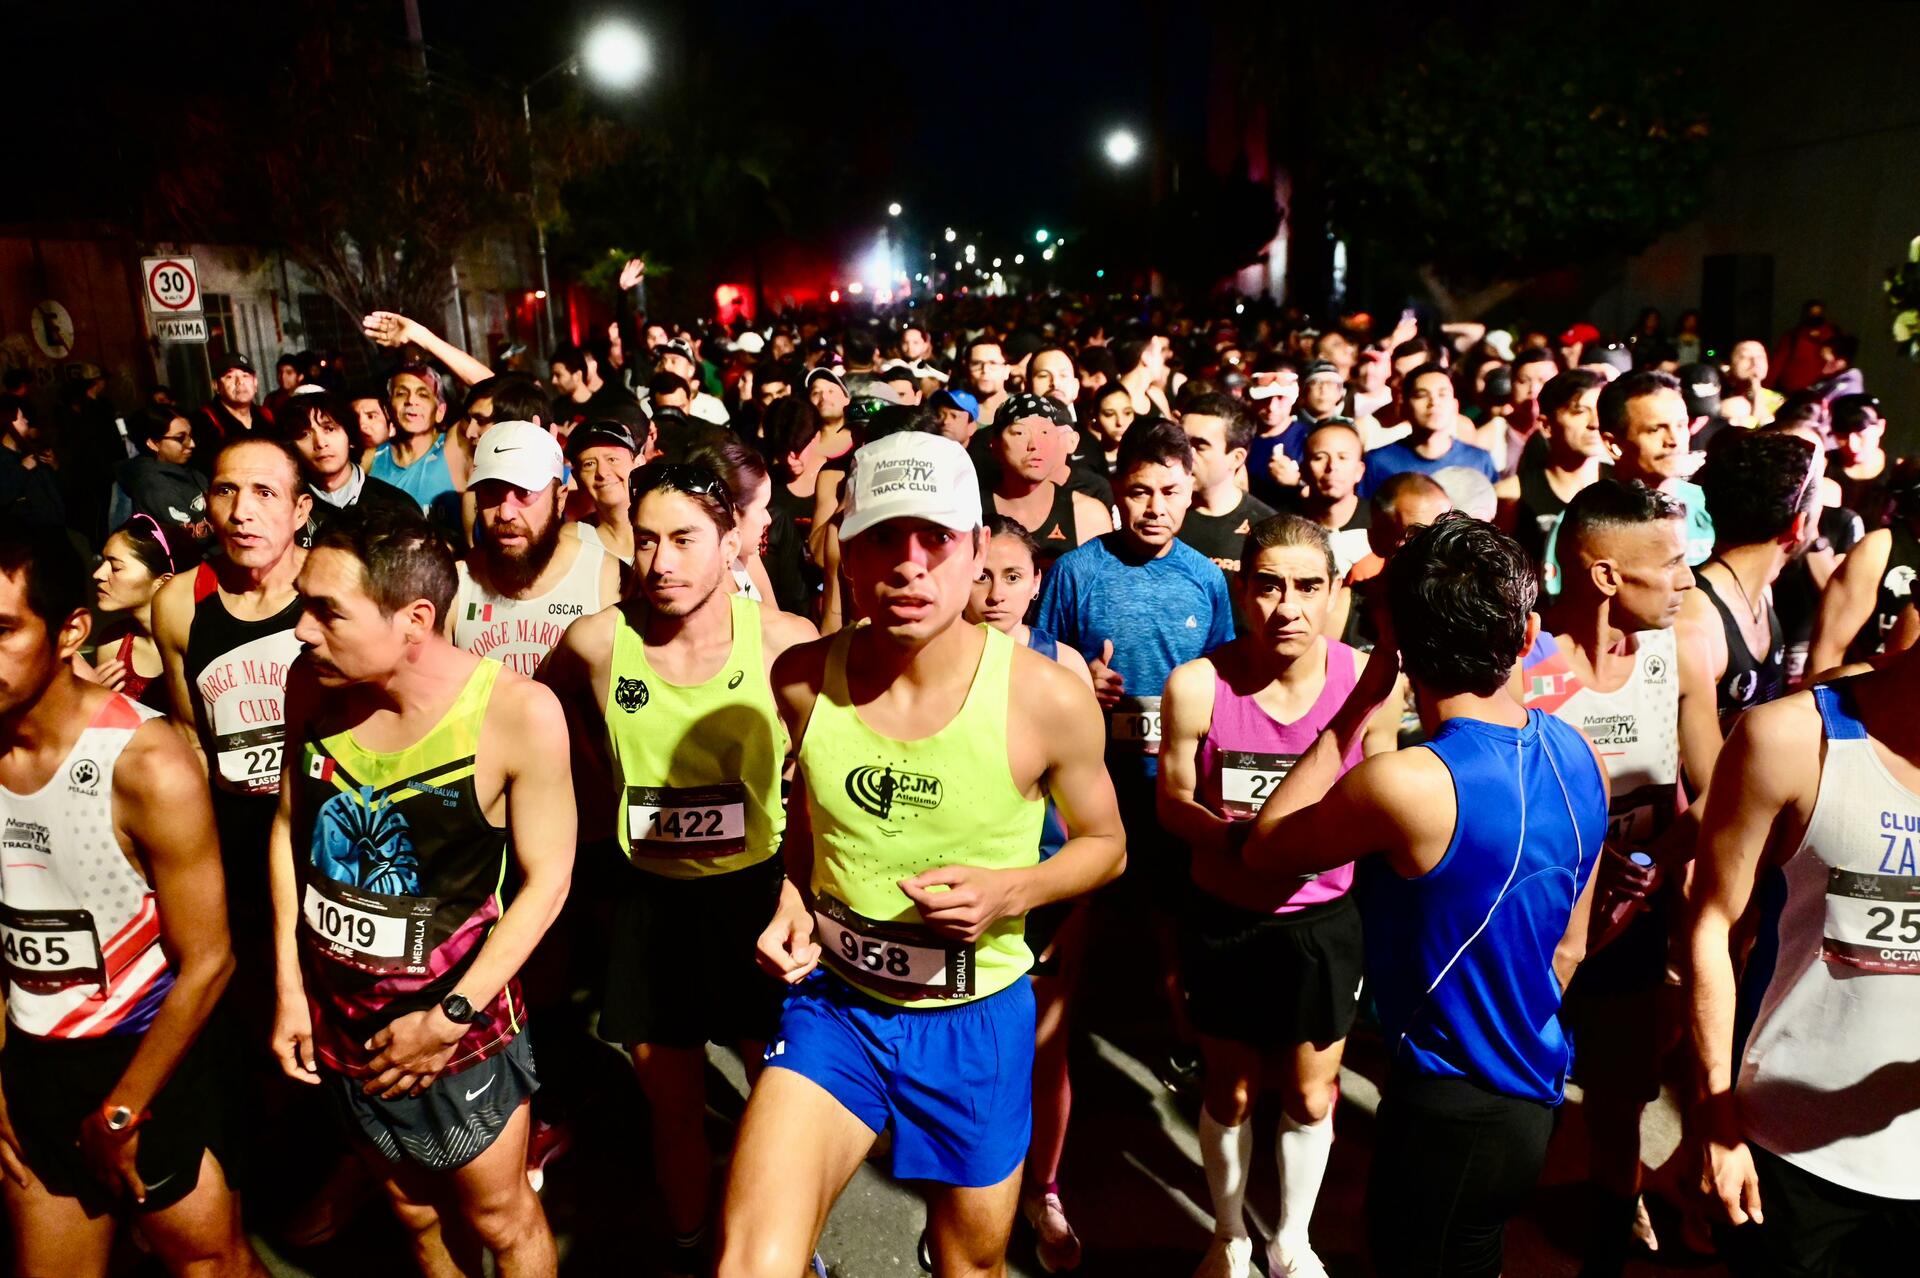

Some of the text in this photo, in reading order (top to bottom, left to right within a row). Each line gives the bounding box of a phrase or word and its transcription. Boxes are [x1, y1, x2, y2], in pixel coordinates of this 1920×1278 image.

[158, 271, 184, 292] 30
[158, 323, 203, 336] MAXIMA
[873, 458, 933, 472] Marathon
[912, 468, 934, 481] TV
[871, 482, 938, 497] TRACK CLUB
[548, 603, 584, 615] OSCAR
[202, 663, 238, 705] ORGE
[239, 698, 281, 724] CLUB
[1583, 714, 1635, 725] Marathon
[1617, 722, 1635, 736] TV
[1613, 736, 1639, 745] CLUB
[244, 745, 284, 775] 22
[248, 777, 270, 787] BLAS
[900, 774, 940, 796] CJM
[895, 792, 937, 806] Atletismo
[6, 817, 49, 832] Marathon
[649, 809, 724, 839] 1422
[2, 841, 32, 849] TRACK
[36, 831, 50, 844] TV
[1878, 833, 1920, 878] ZA
[317, 901, 376, 948] 1019
[1865, 906, 1920, 943] 25
[5, 932, 70, 966] 465
[411, 919, 426, 966] MEDALLA
[840, 930, 911, 977] 958
[956, 950, 966, 992] MEDALLA
